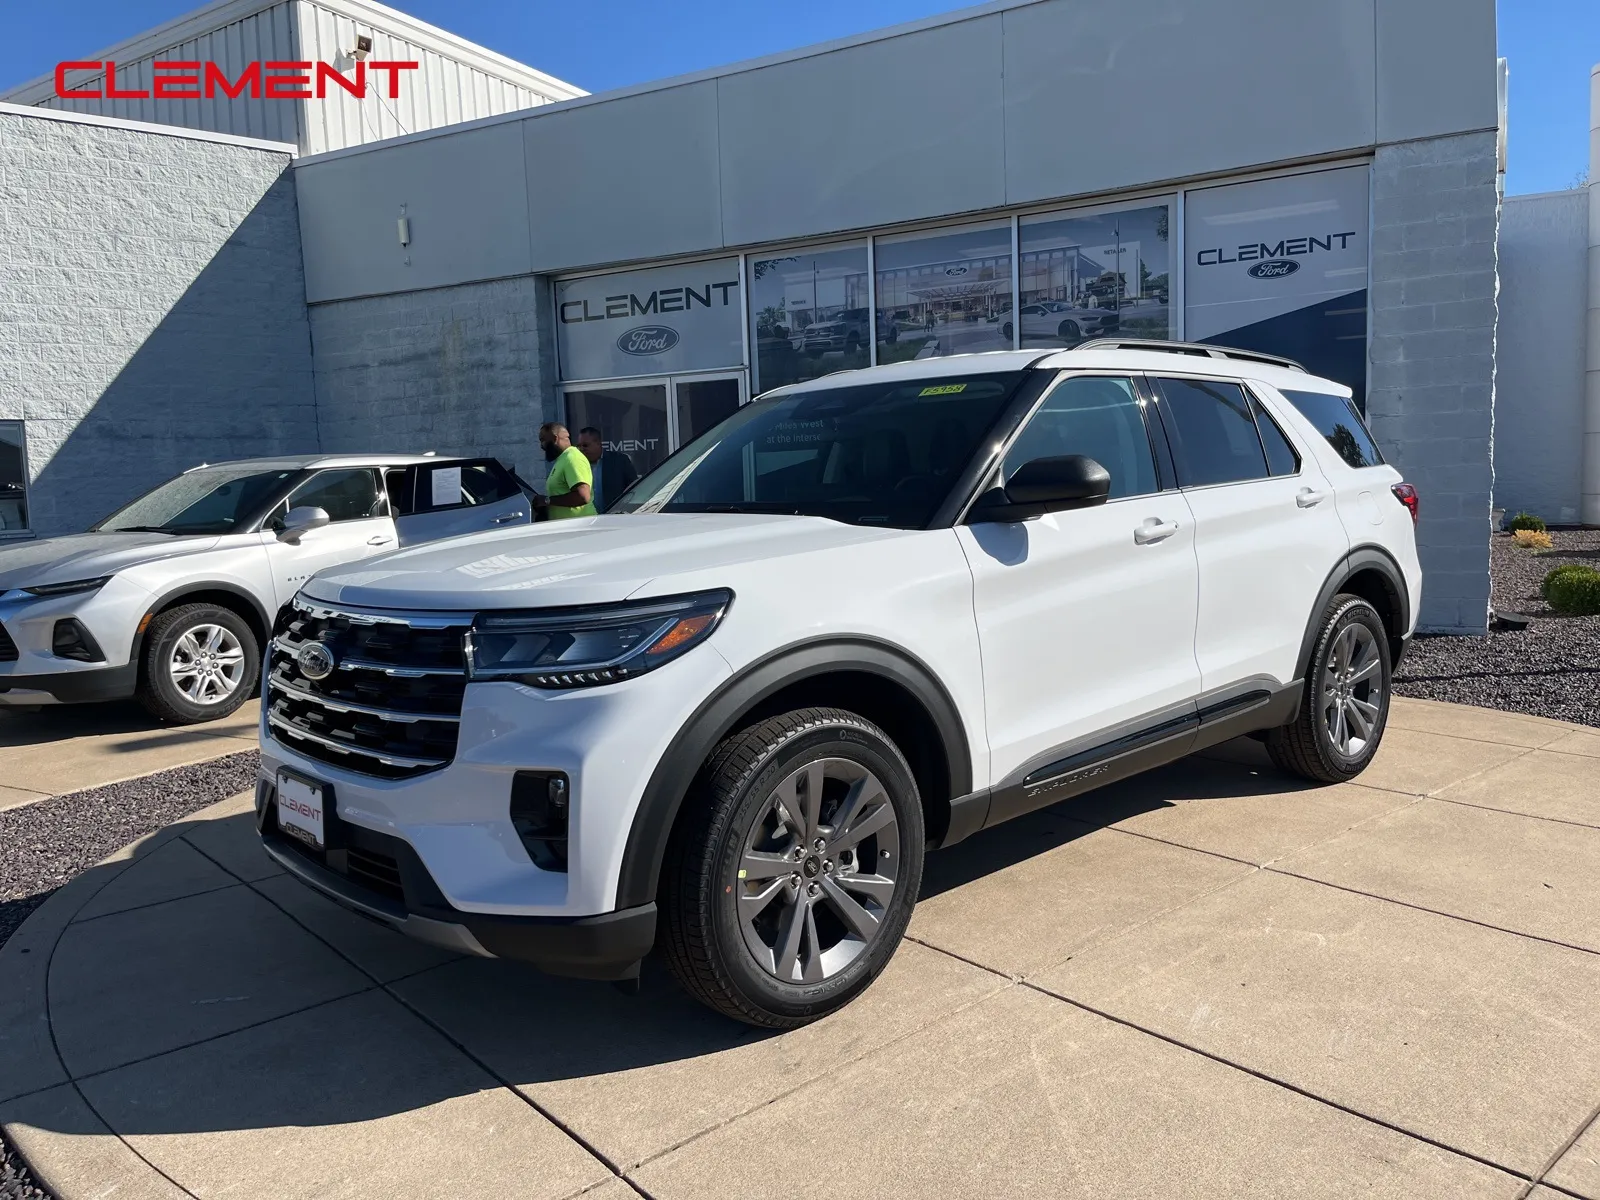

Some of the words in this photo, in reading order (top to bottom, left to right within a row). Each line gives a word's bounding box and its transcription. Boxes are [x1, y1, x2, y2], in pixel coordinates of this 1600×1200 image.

[1197, 231, 1356, 266] CLEMENT
[1257, 262, 1289, 277] Ford
[560, 280, 739, 324] CLEMENT
[628, 330, 668, 351] Ford
[601, 438, 659, 453] EMENT
[279, 793, 322, 822] CLEMENT
